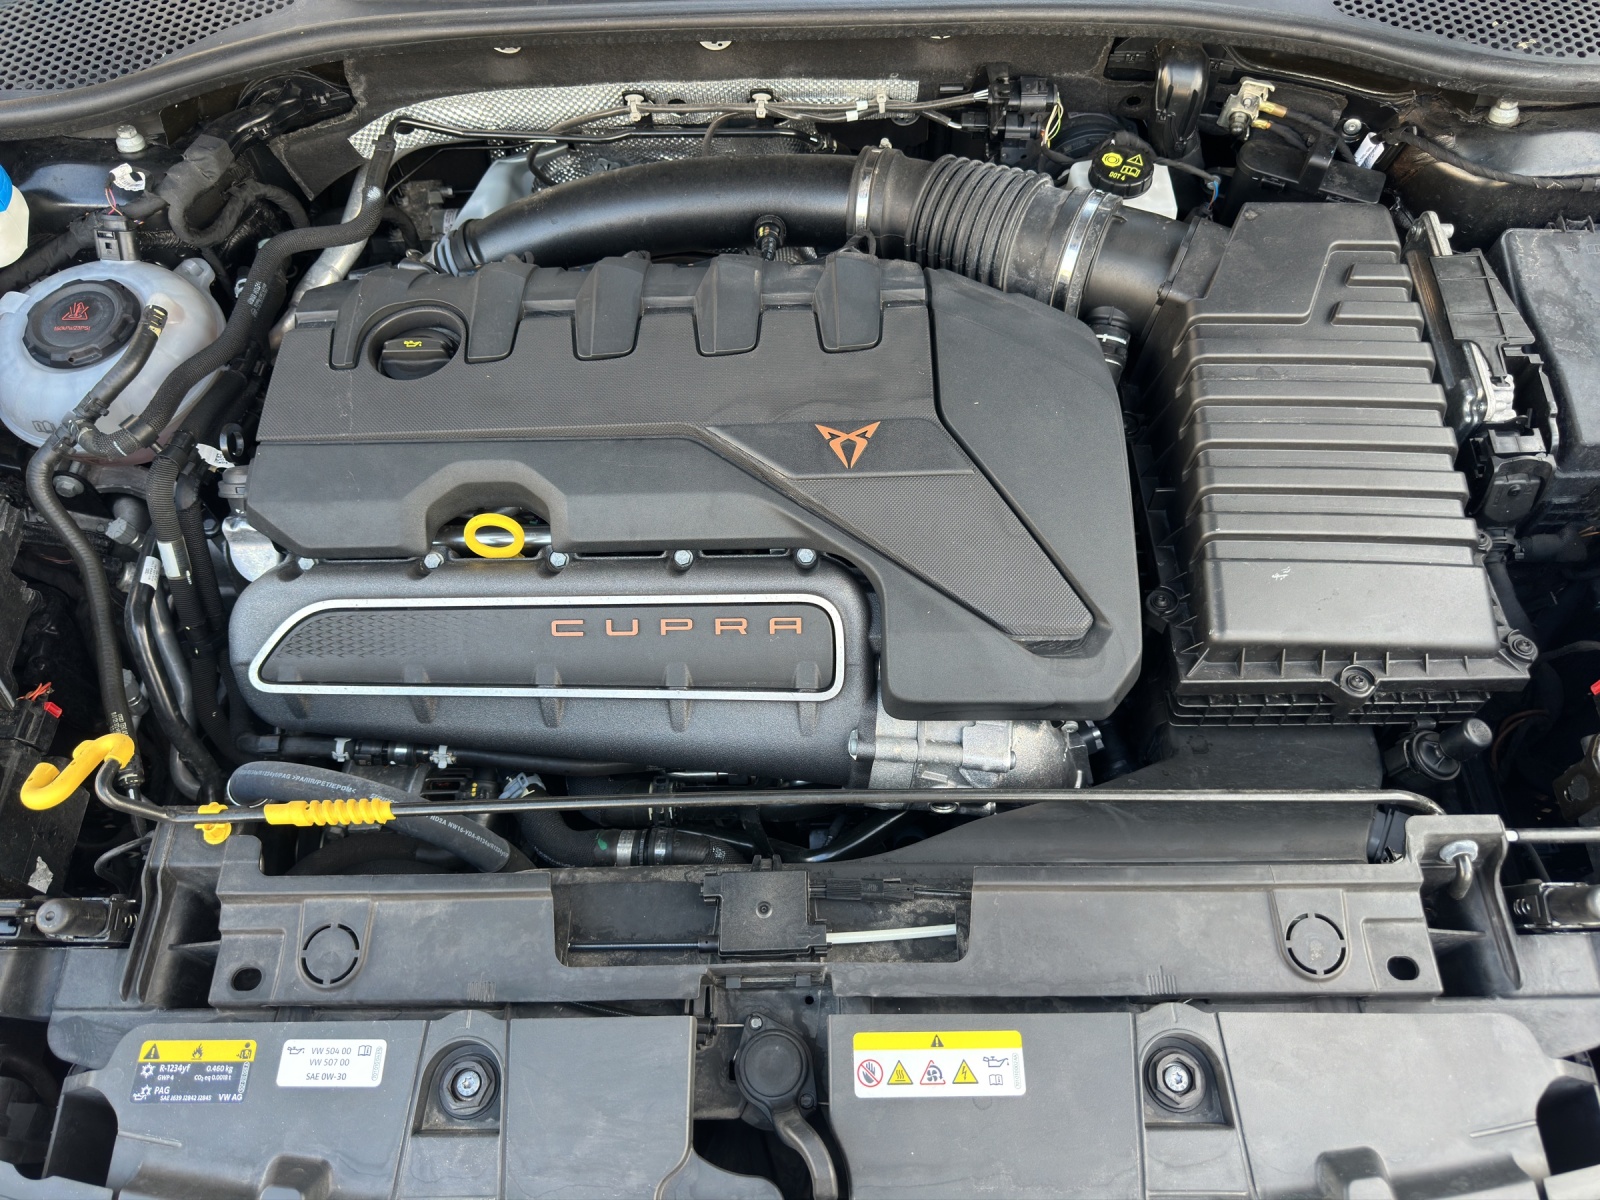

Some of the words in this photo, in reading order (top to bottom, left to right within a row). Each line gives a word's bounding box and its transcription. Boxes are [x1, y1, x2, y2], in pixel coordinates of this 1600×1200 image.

[1109, 171, 1121, 179] DOT
[551, 617, 802, 636] CUPRA
[309, 1058, 321, 1066] VW
[323, 1058, 338, 1066] 507
[339, 1058, 350, 1066] 00
[159, 1064, 191, 1074] R-1234yf
[225, 1064, 233, 1073] kg
[306, 1072, 319, 1080] SAE
[321, 1072, 346, 1080] 0W-30
[154, 1086, 170, 1094] PAG
